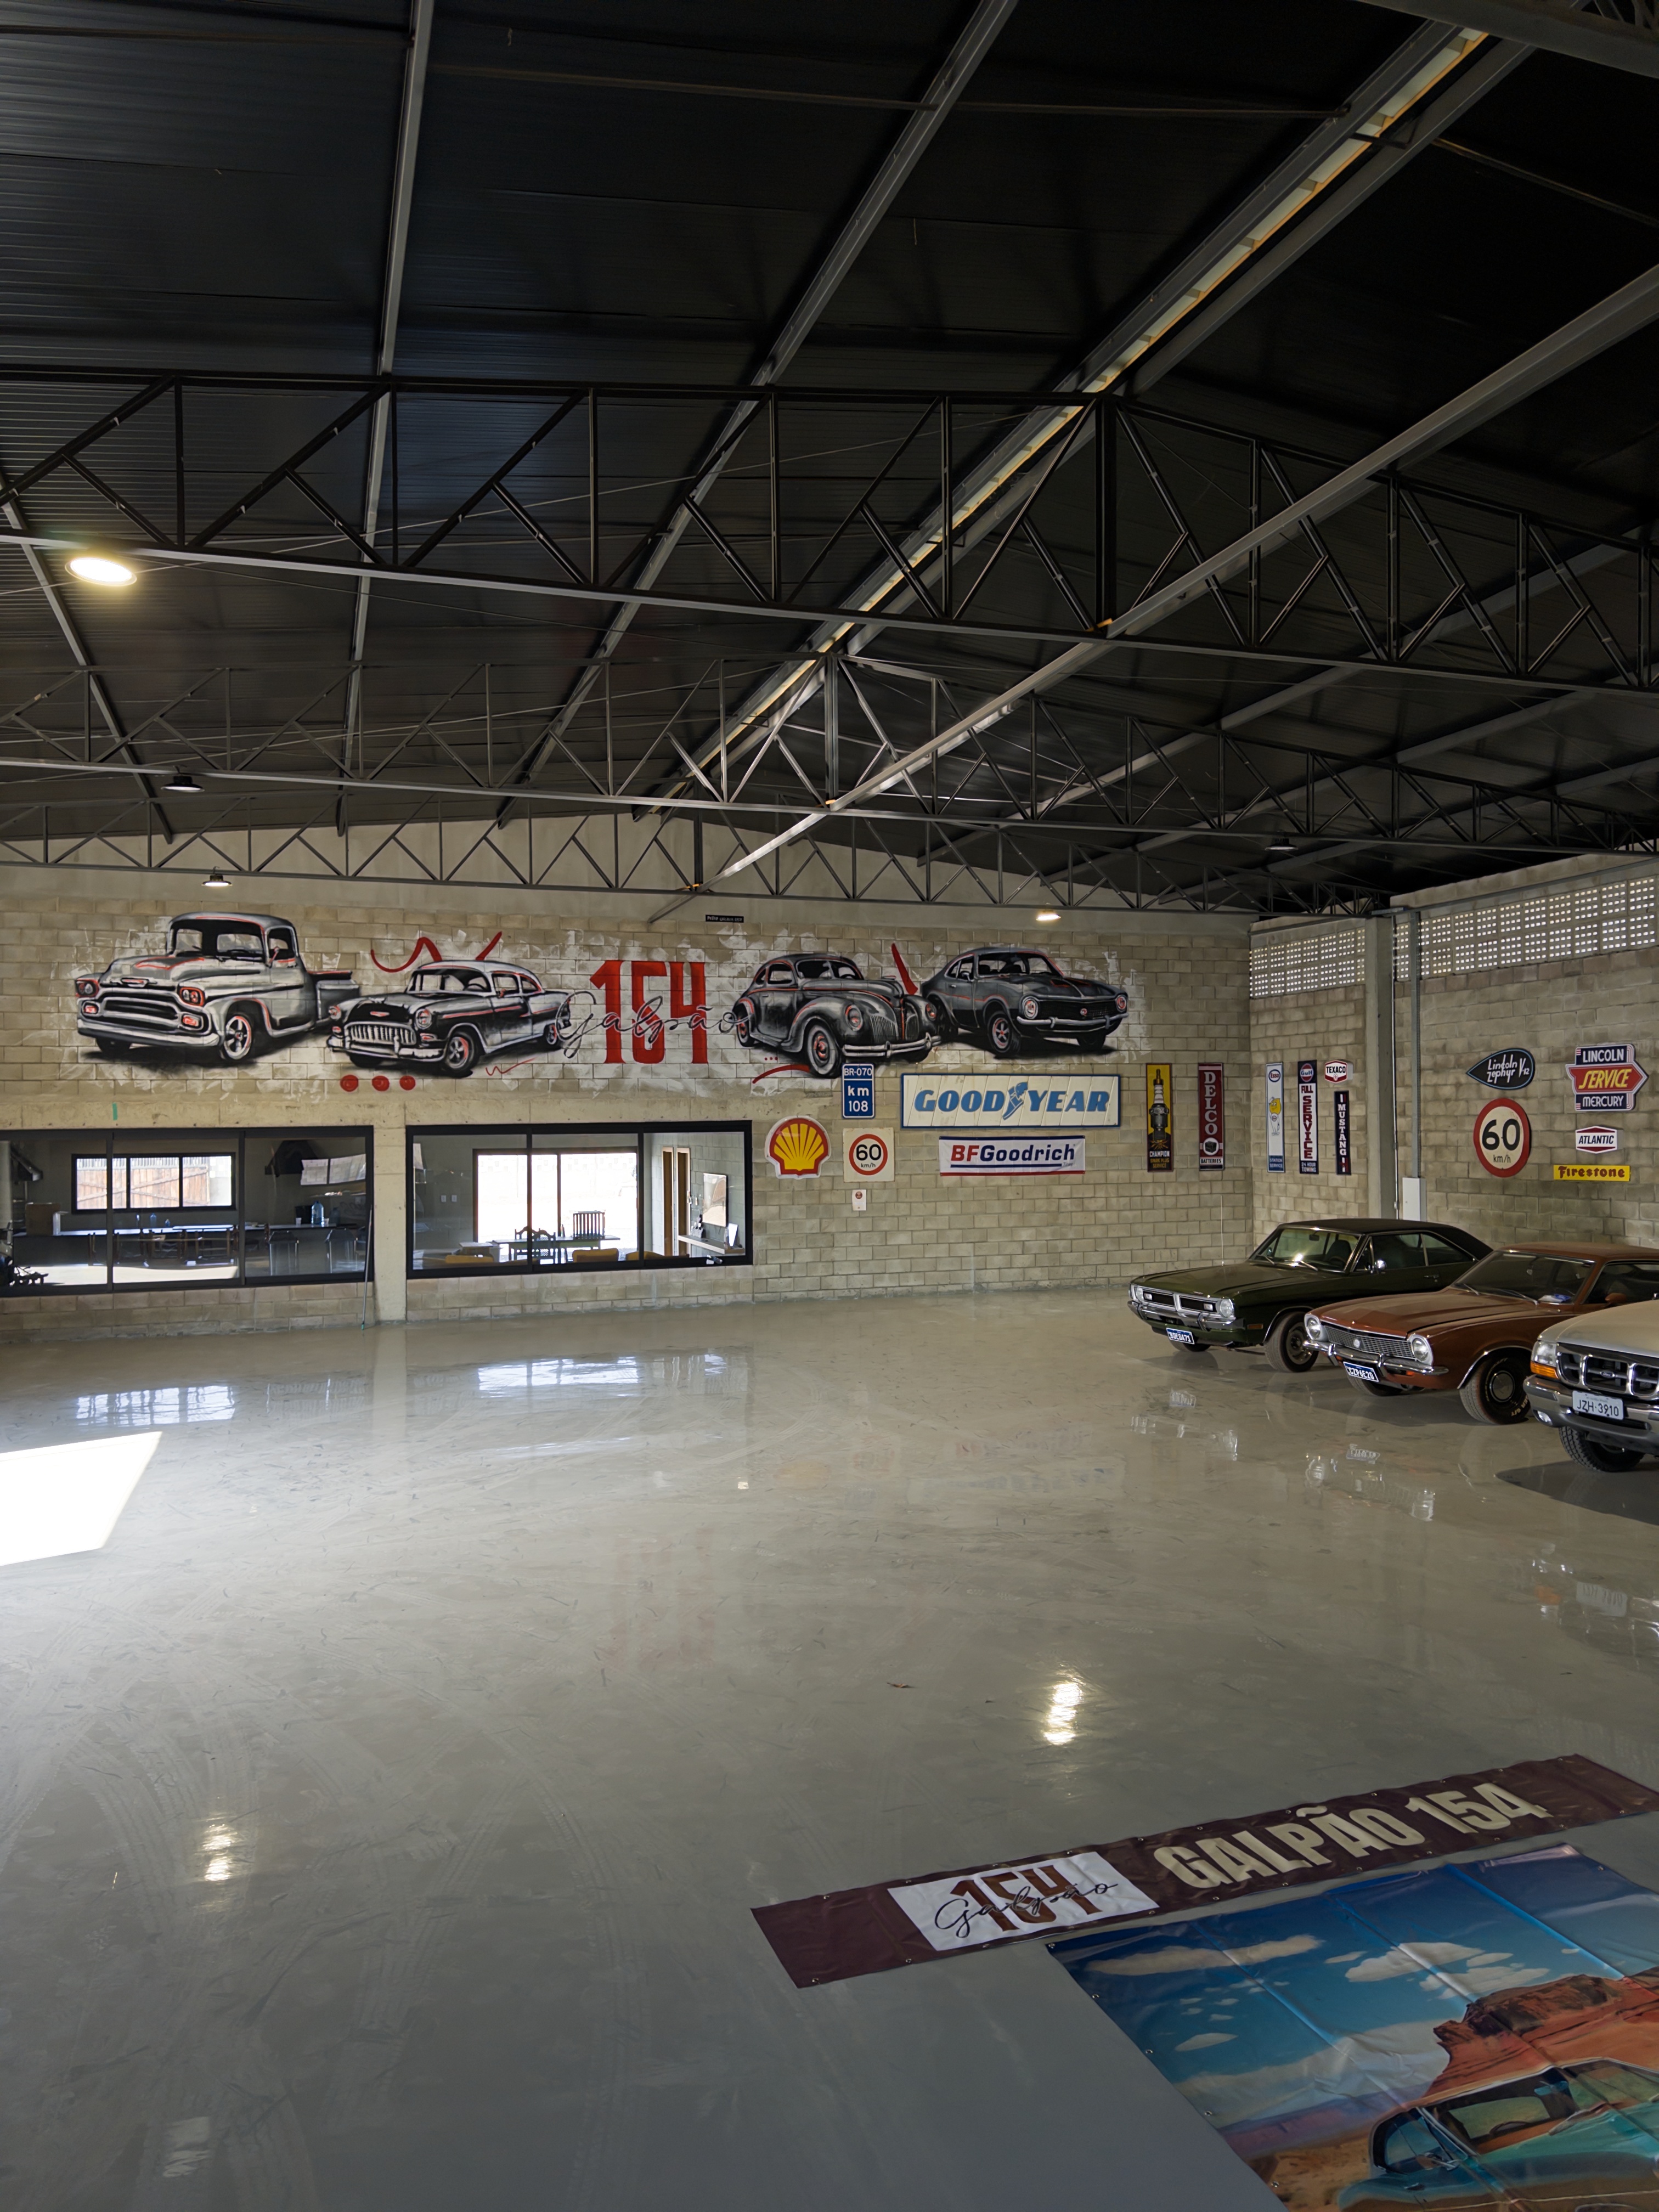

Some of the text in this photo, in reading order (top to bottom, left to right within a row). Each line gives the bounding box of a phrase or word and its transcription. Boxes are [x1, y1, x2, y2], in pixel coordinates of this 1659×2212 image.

[589, 960, 708, 1064] 154
[1488, 1054, 1517, 1070] Lincoln
[1583, 1049, 1624, 1063] LINCOLN
[844, 1068, 872, 1076] BR-070
[1578, 1069, 1632, 1089] SERVICE
[848, 1085, 869, 1096] km
[1301, 1085, 1313, 1093] FULL
[849, 1101, 868, 1112] 108
[1204, 1071, 1217, 1135] DELCO
[1583, 1096, 1624, 1107] MERCURY
[1302, 1096, 1313, 1159] SERVICE
[1338, 1104, 1347, 1156] MUSTANG
[1482, 1118, 1520, 1150] 60
[1578, 1135, 1614, 1144] ATLANTIC
[856, 1144, 882, 1160] 60
[951, 1144, 1074, 1161] BFGoodrich
[1493, 1154, 1511, 1163] km/h
[1558, 1166, 1625, 1178] Firestone
[1154, 1783, 1554, 1888] GALPÃO 154
[950, 1865, 1103, 1932] 154
